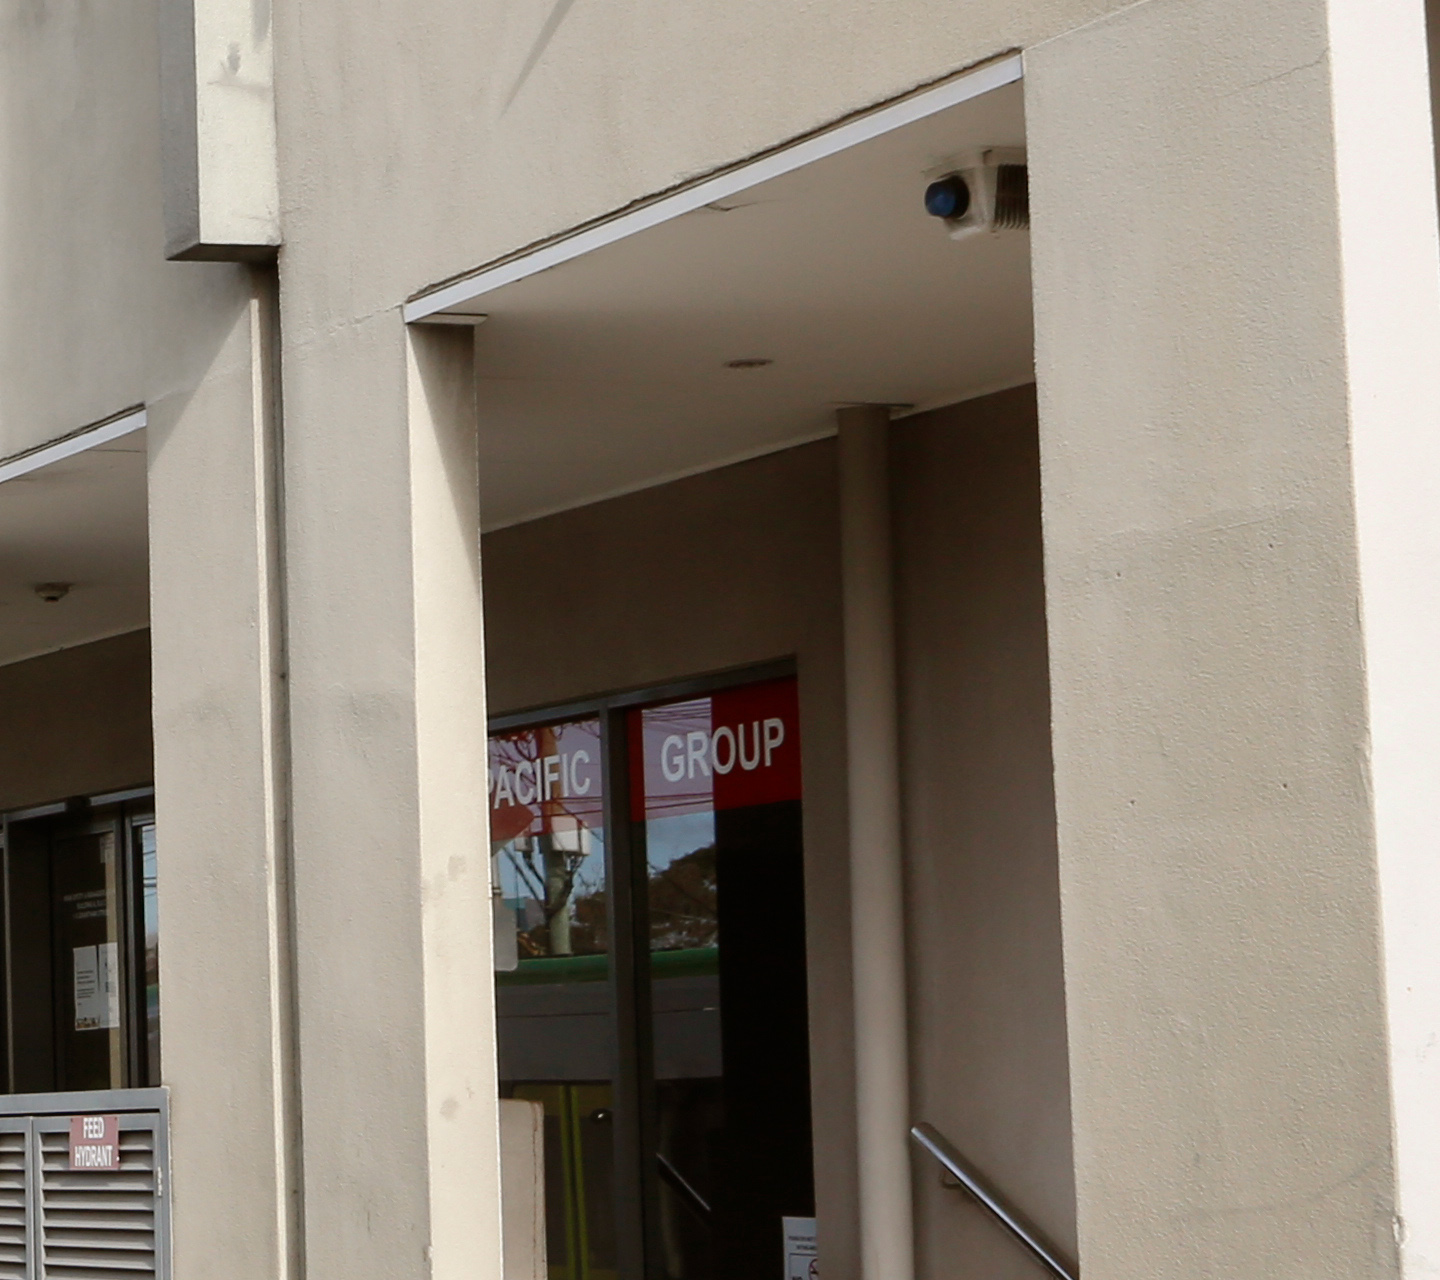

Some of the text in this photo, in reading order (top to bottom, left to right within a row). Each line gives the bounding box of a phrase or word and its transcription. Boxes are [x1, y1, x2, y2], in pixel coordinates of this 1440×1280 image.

[660, 717, 785, 783] GROUP
[83, 1116, 104, 1139] FEED
[74, 1145, 113, 1167] HYDRANT
